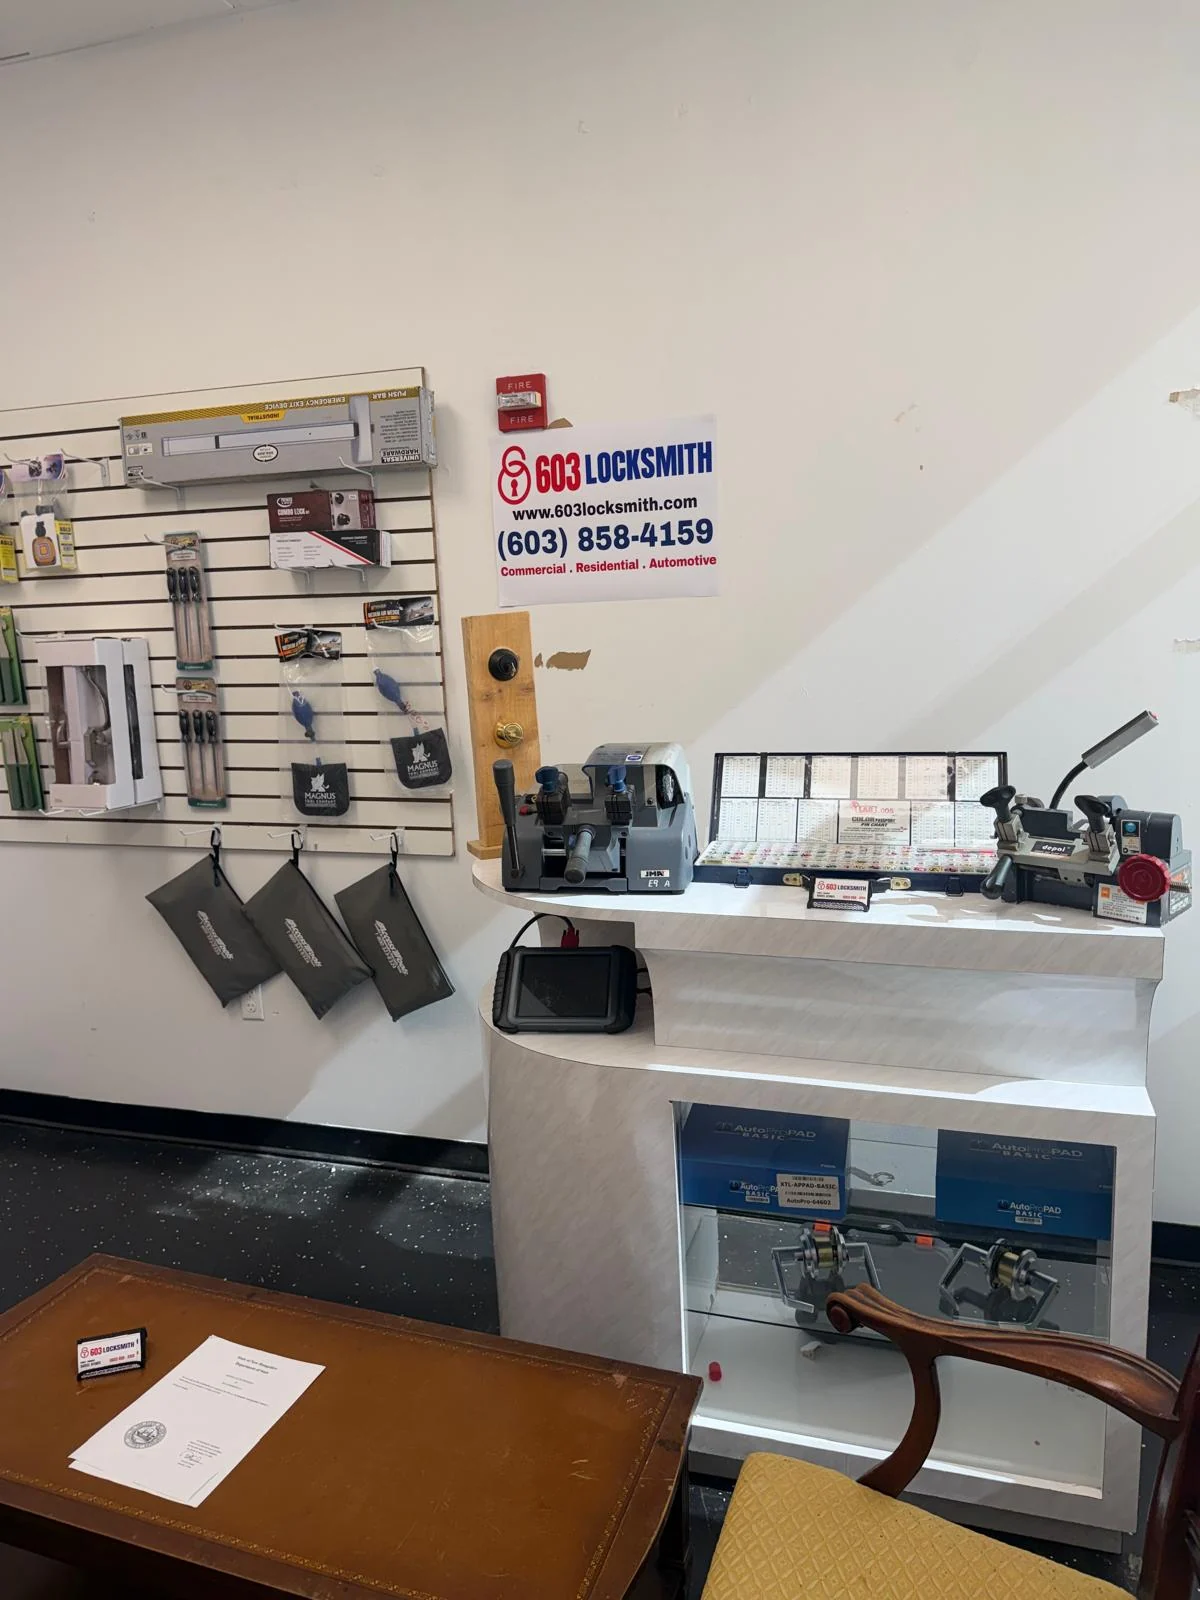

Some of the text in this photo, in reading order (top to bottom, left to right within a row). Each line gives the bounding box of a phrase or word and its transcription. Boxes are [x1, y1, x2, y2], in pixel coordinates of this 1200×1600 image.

[507, 381, 532, 390] FIRE
[387, 390, 407, 398] PUSH
[264, 396, 346, 410] EMERGENCY EXIT DEVICE
[247, 412, 280, 421] INDUSTRIAL
[510, 415, 534, 424] FIRE
[383, 447, 419, 457] HARDWARE
[383, 454, 420, 463] UNIVERSAL
[535, 441, 713, 494] 603 LOCKSMITH
[512, 497, 698, 521] www.603locksmith.com
[498, 518, 714, 561] (603) 858-4159
[501, 563, 567, 577] Commercial
[575, 559, 639, 573] Residential
[649, 555, 717, 569] Automotive
[407, 760, 438, 773] MAGNUS
[304, 792, 336, 800] MAGNUS
[837, 884, 867, 892] LOCKSMITH
[1009, 1202, 1061, 1215] AutoProPAD
[1015, 1209, 1042, 1217] BASIC
[102, 1341, 135, 1354] LOCKSMITH
